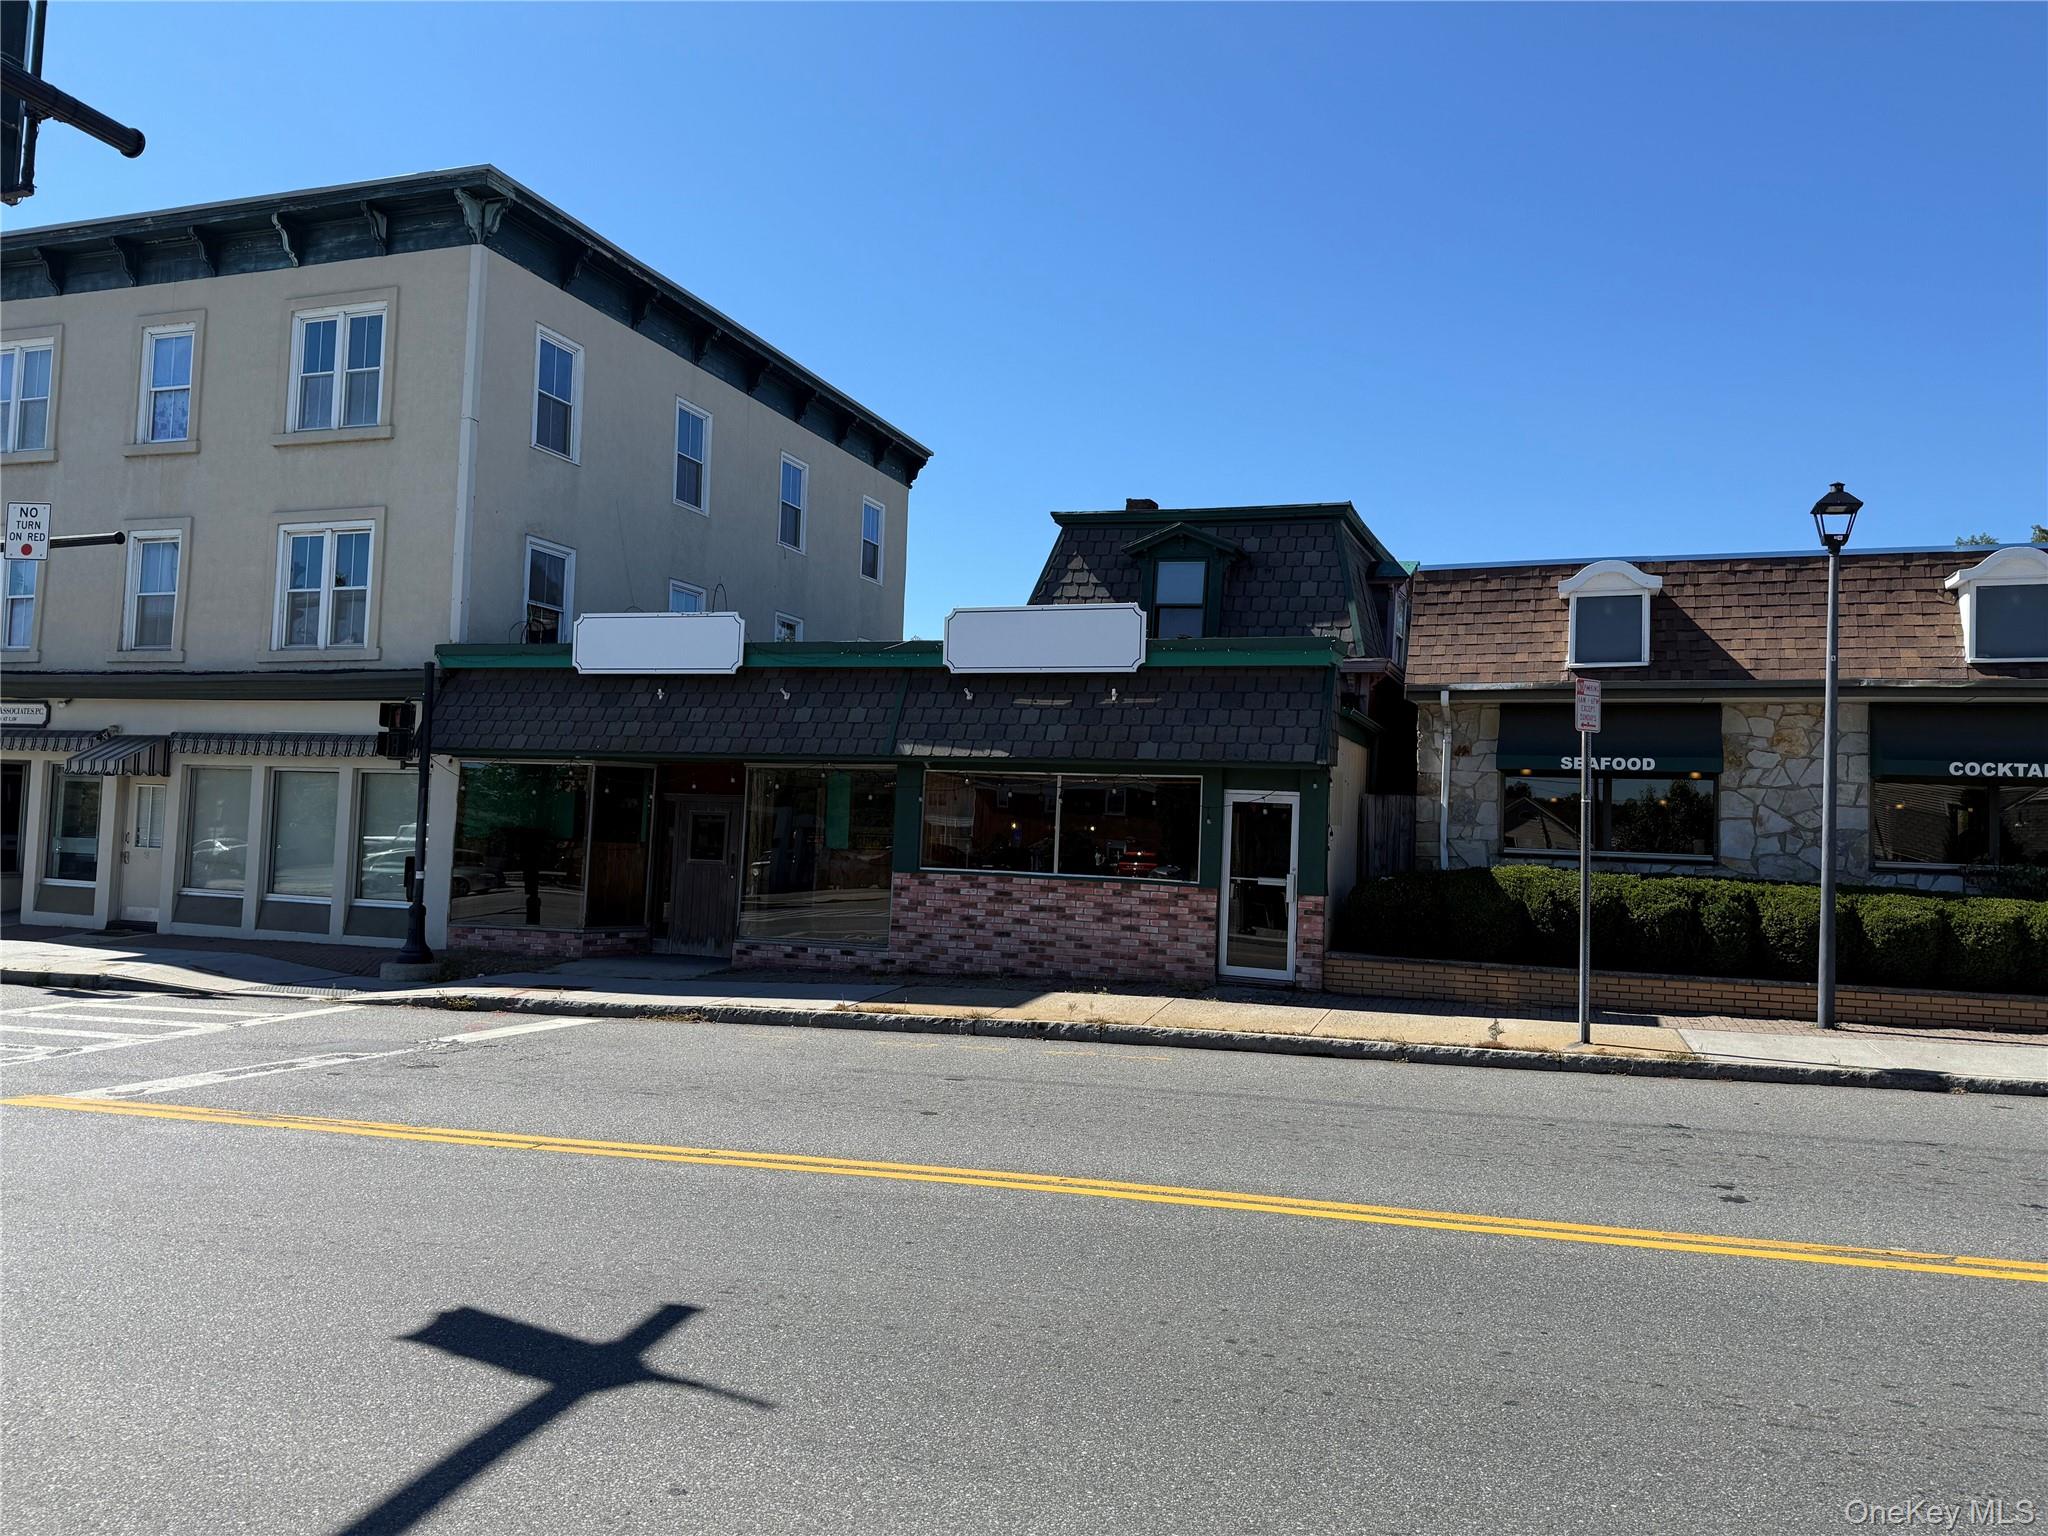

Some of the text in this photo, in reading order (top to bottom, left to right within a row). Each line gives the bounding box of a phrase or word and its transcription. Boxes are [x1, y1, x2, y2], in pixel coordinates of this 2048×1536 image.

[20, 507, 38, 518] NO
[16, 520, 41, 530] TURN
[9, 531, 46, 542] ON RED
[1560, 757, 1656, 771] SEAFOOD
